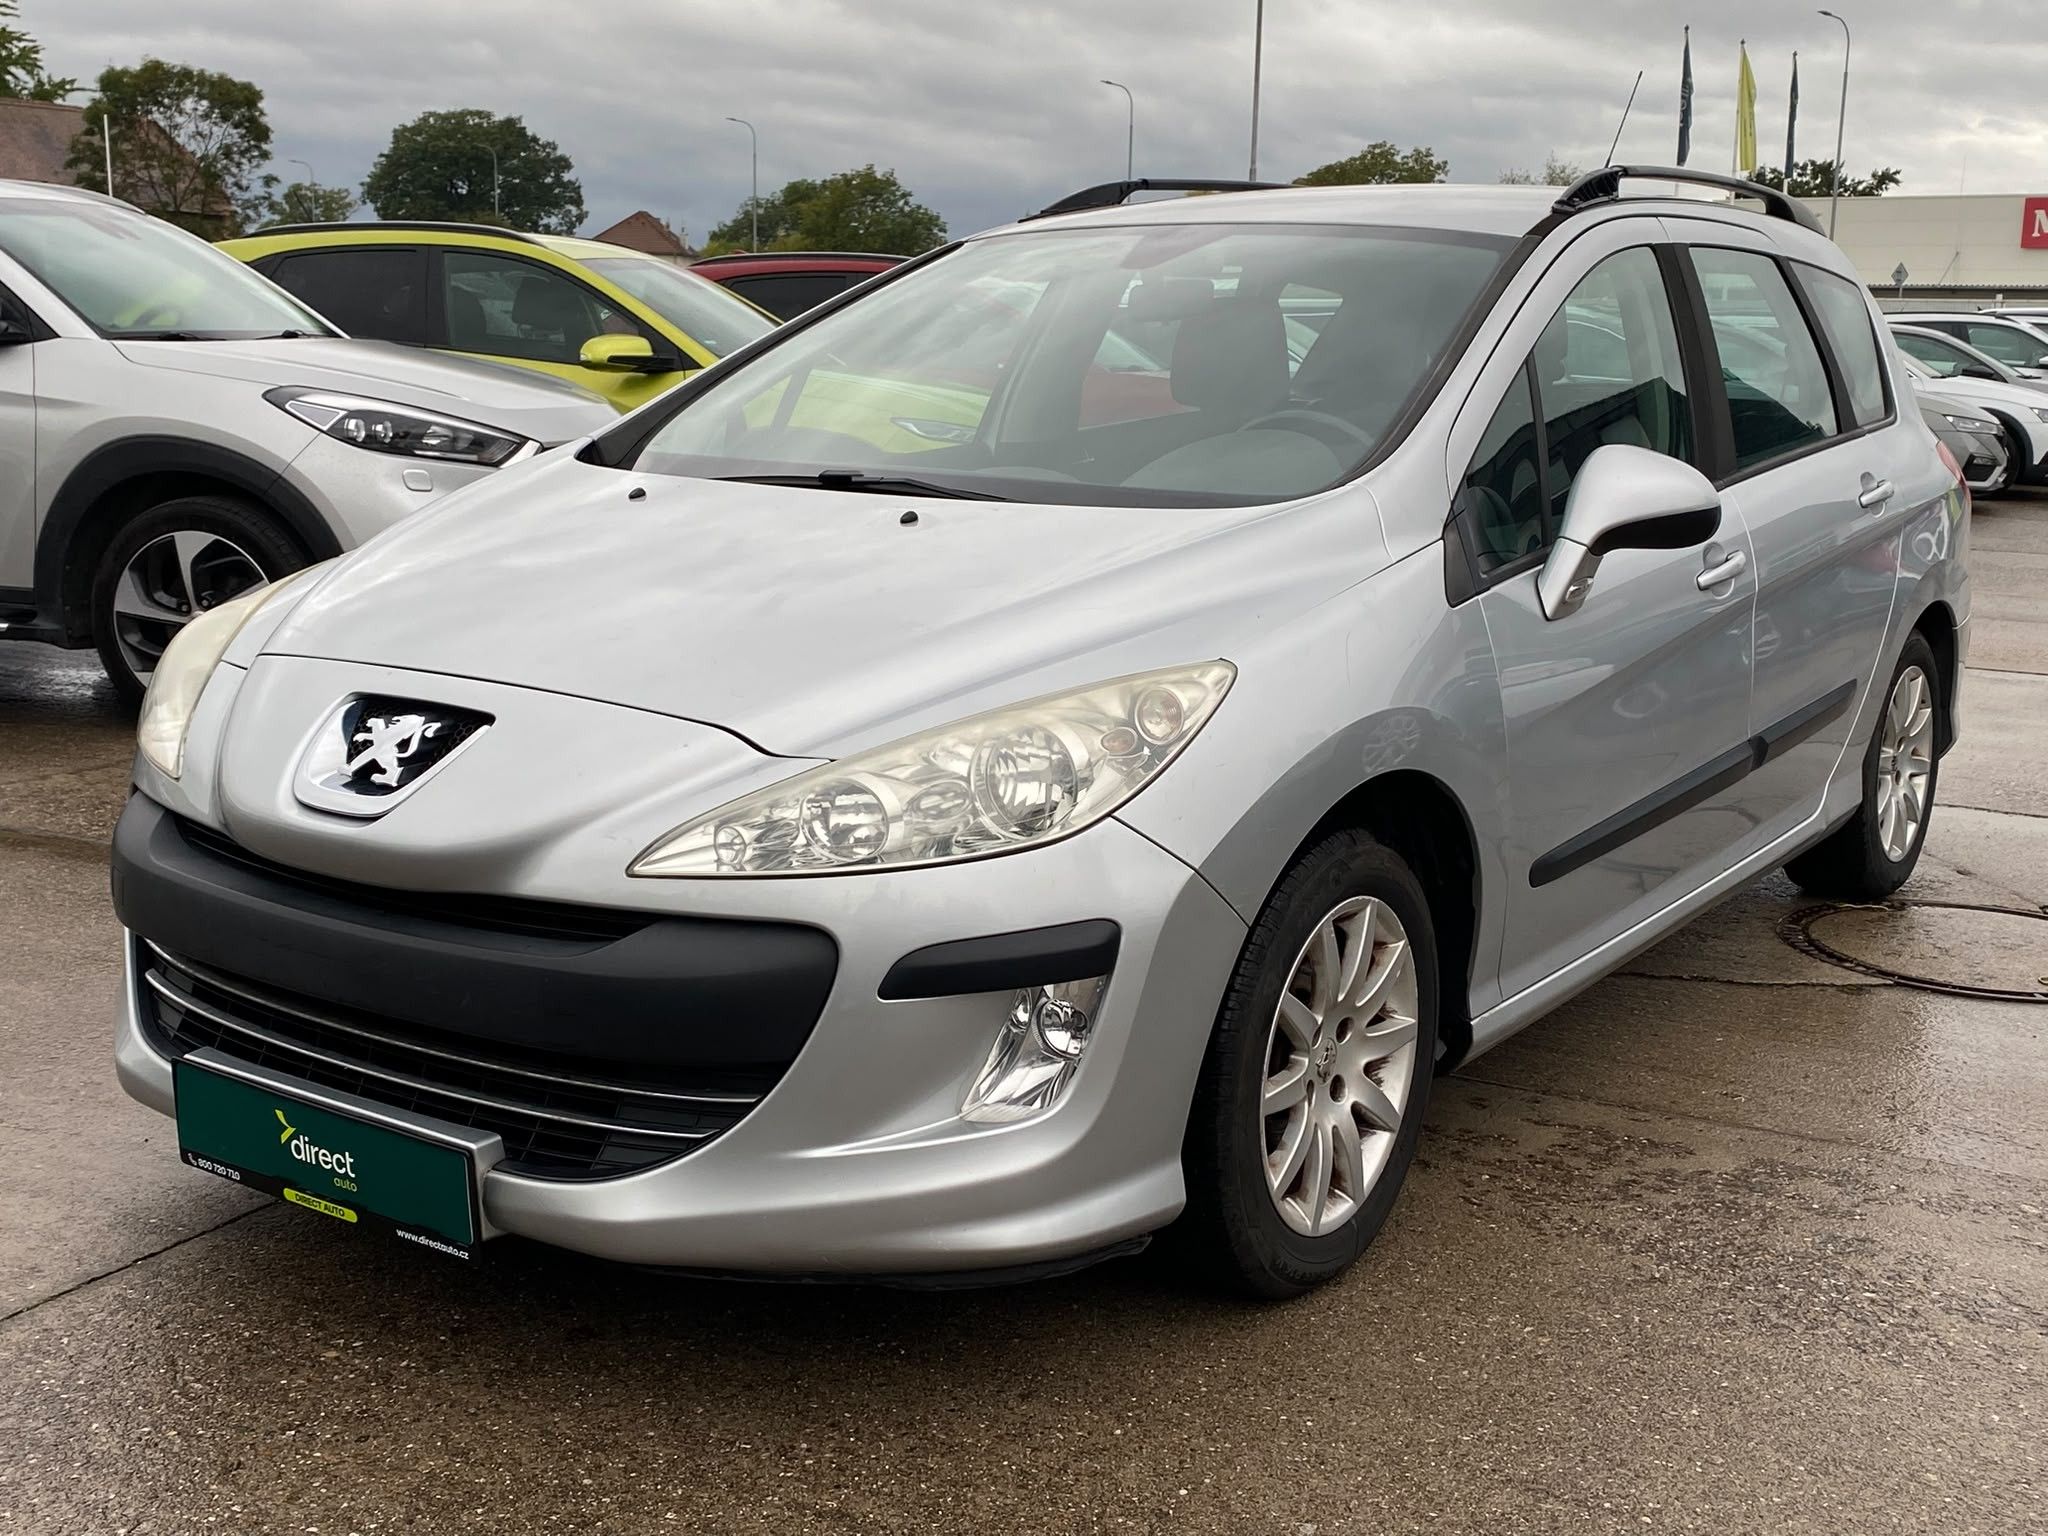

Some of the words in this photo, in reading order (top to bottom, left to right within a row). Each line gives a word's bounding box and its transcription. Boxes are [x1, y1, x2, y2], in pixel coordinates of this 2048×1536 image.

[290, 1134, 356, 1178] direct
[213, 1163, 226, 1175] 720
[333, 1177, 358, 1192] auto
[295, 1193, 322, 1210] DIRECT
[323, 1203, 345, 1217] AUTO
[396, 1229, 469, 1260] www.directauto.cz
